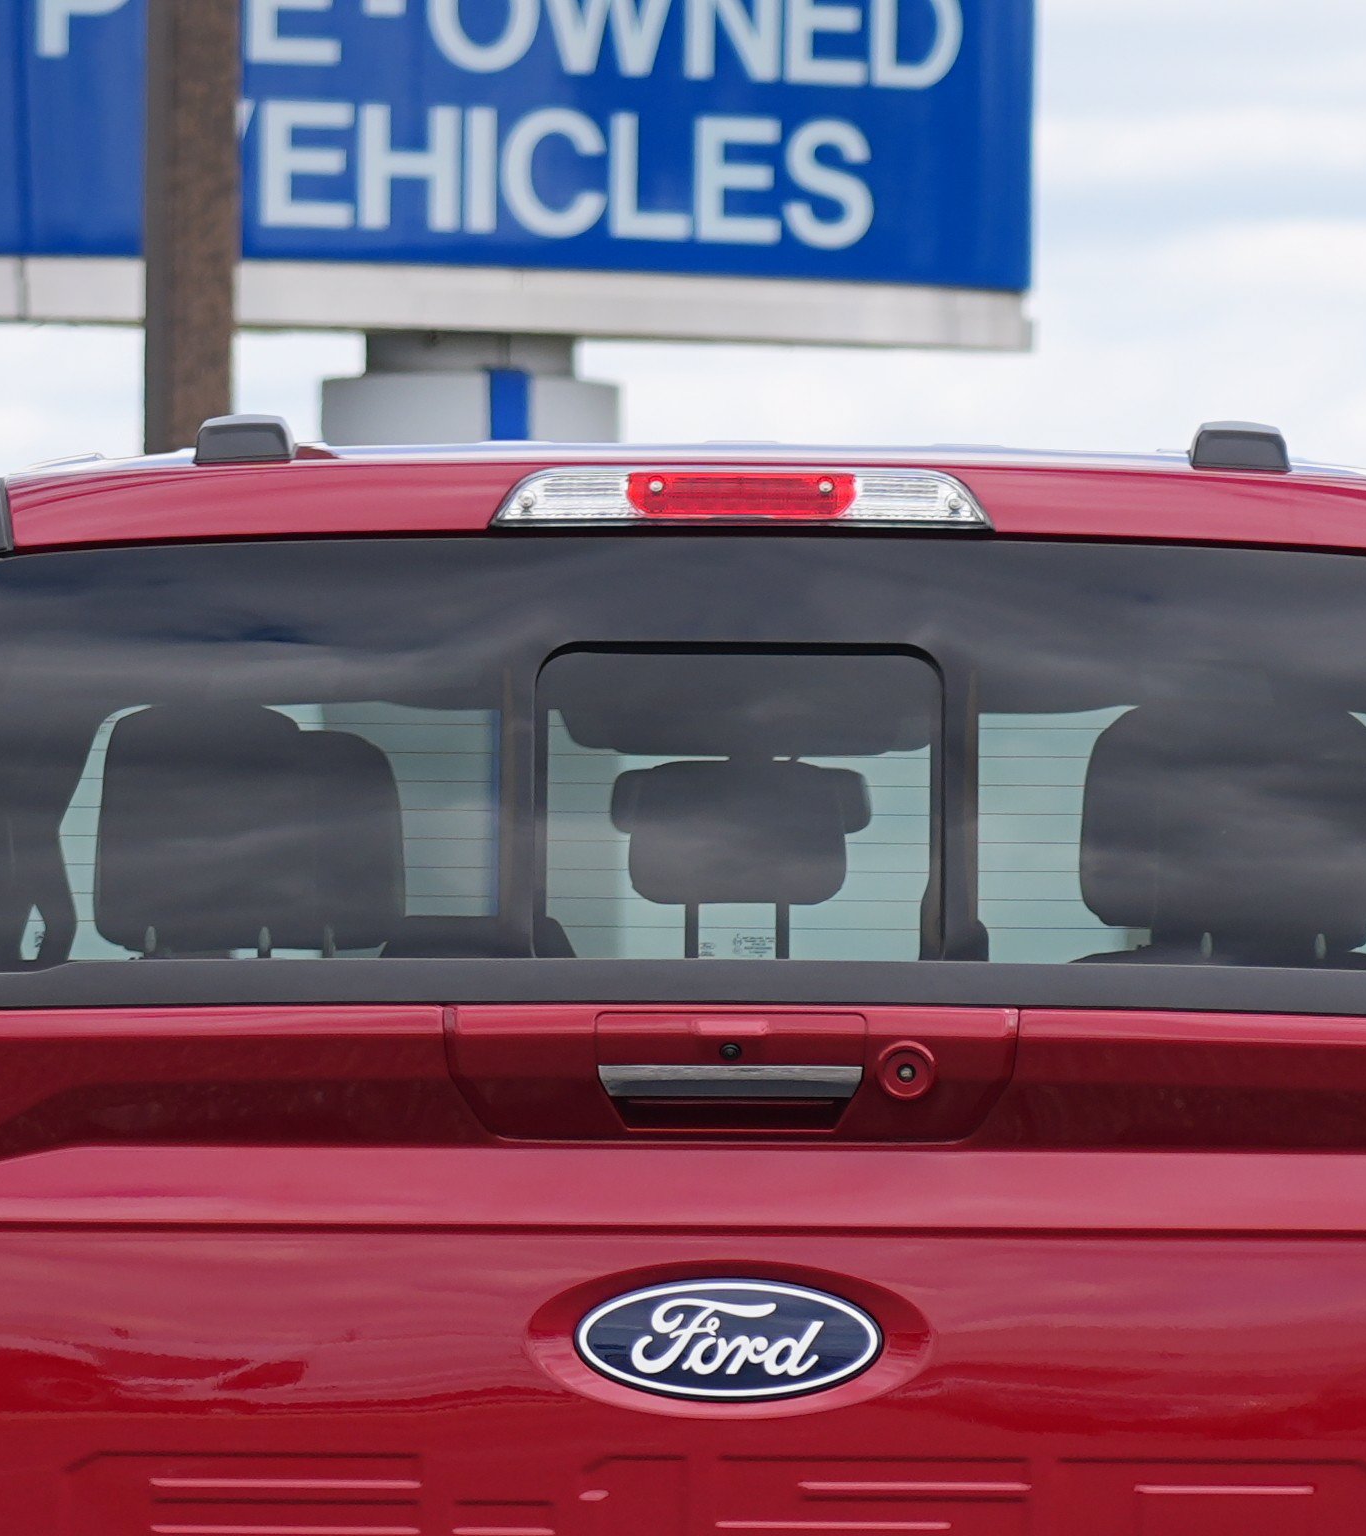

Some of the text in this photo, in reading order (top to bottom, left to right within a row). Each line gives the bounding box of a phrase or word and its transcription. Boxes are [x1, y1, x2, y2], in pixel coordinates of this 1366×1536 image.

[37, 0, 964, 90] E-OWNED
[235, 99, 875, 250] EHICLES
[630, 1298, 825, 1377] Ford
